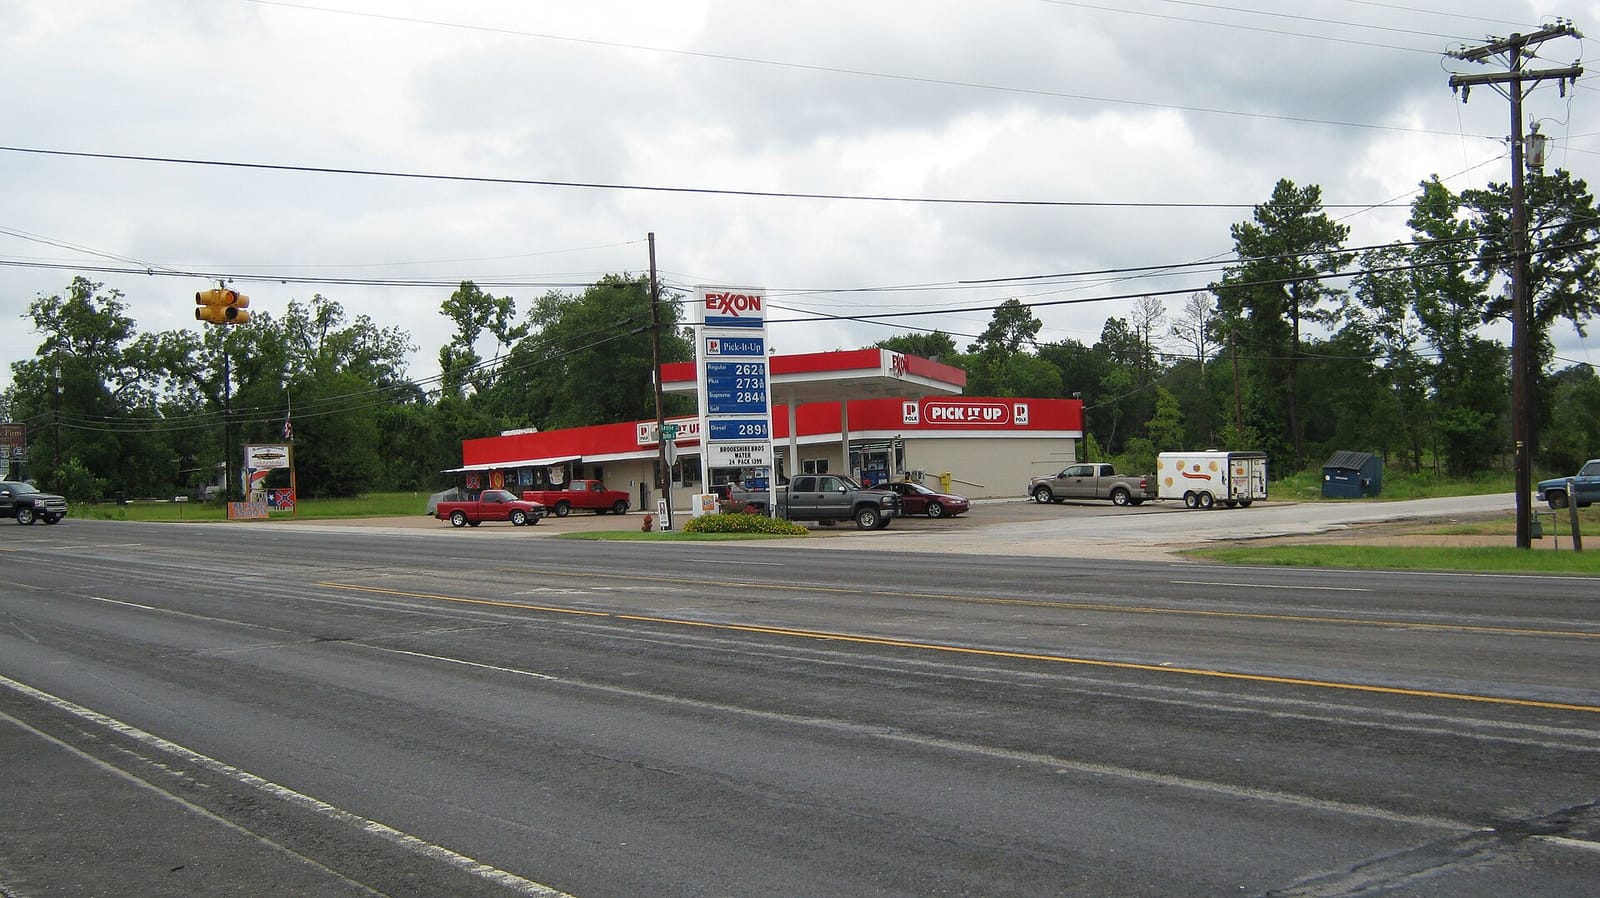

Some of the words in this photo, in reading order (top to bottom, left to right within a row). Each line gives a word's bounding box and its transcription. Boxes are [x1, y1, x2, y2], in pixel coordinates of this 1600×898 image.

[705, 292, 761, 317] EXXON
[708, 363, 727, 371] Regular
[736, 364, 758, 375] 262
[736, 377, 759, 389] 273
[709, 391, 731, 399] Supreme
[736, 391, 760, 403] 284
[932, 407, 964, 420] PICK
[968, 408, 980, 416] IT
[983, 408, 1002, 420] UP
[739, 424, 762, 435] 289
